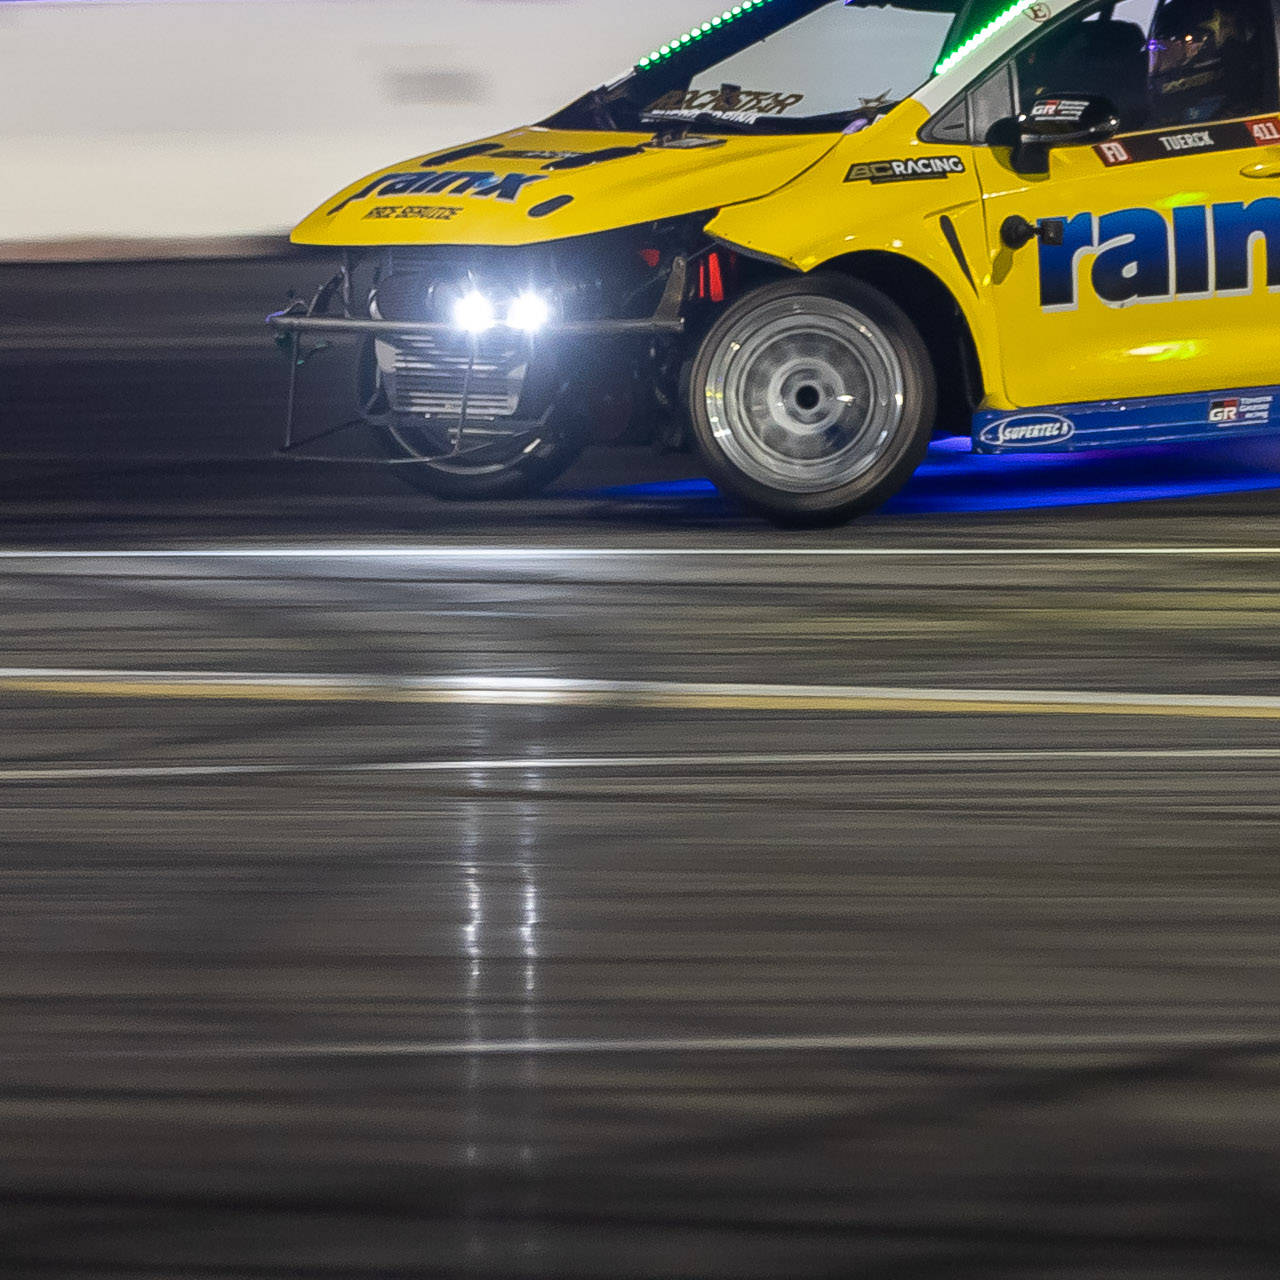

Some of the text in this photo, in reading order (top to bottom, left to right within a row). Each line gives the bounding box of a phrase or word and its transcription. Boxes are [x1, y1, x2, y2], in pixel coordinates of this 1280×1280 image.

[1101, 122, 1280, 163] FD TUERCK 411
[891, 157, 964, 176] RACING
[1209, 406, 1238, 421] GR
